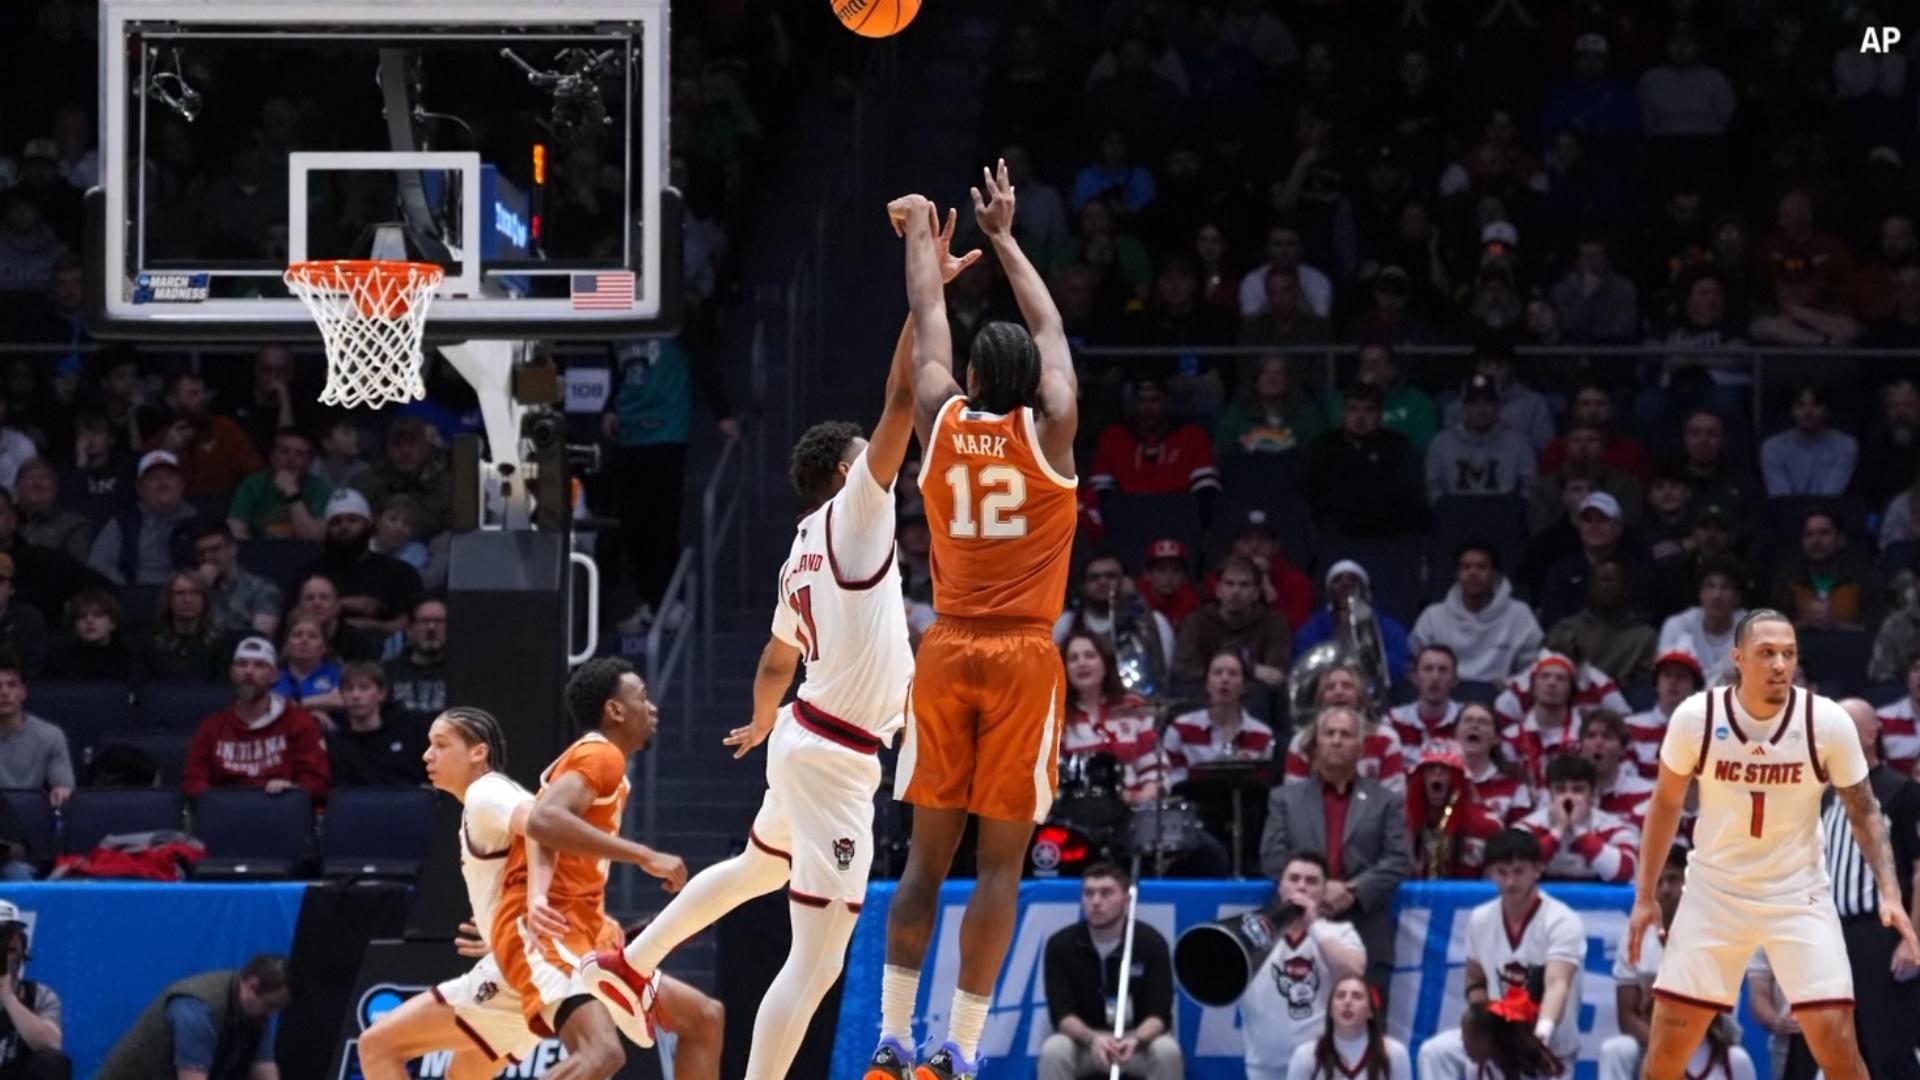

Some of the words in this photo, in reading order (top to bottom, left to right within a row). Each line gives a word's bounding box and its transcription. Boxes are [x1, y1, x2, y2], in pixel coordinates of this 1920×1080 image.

[150, 276, 189, 288] MARCH
[153, 288, 207, 300] MADNESS
[952, 434, 1007, 458] MARK
[945, 464, 1027, 539] 12
[1715, 761, 1741, 782] NC
[1744, 763, 1803, 784] STATE
[1750, 792, 1765, 838] 1
